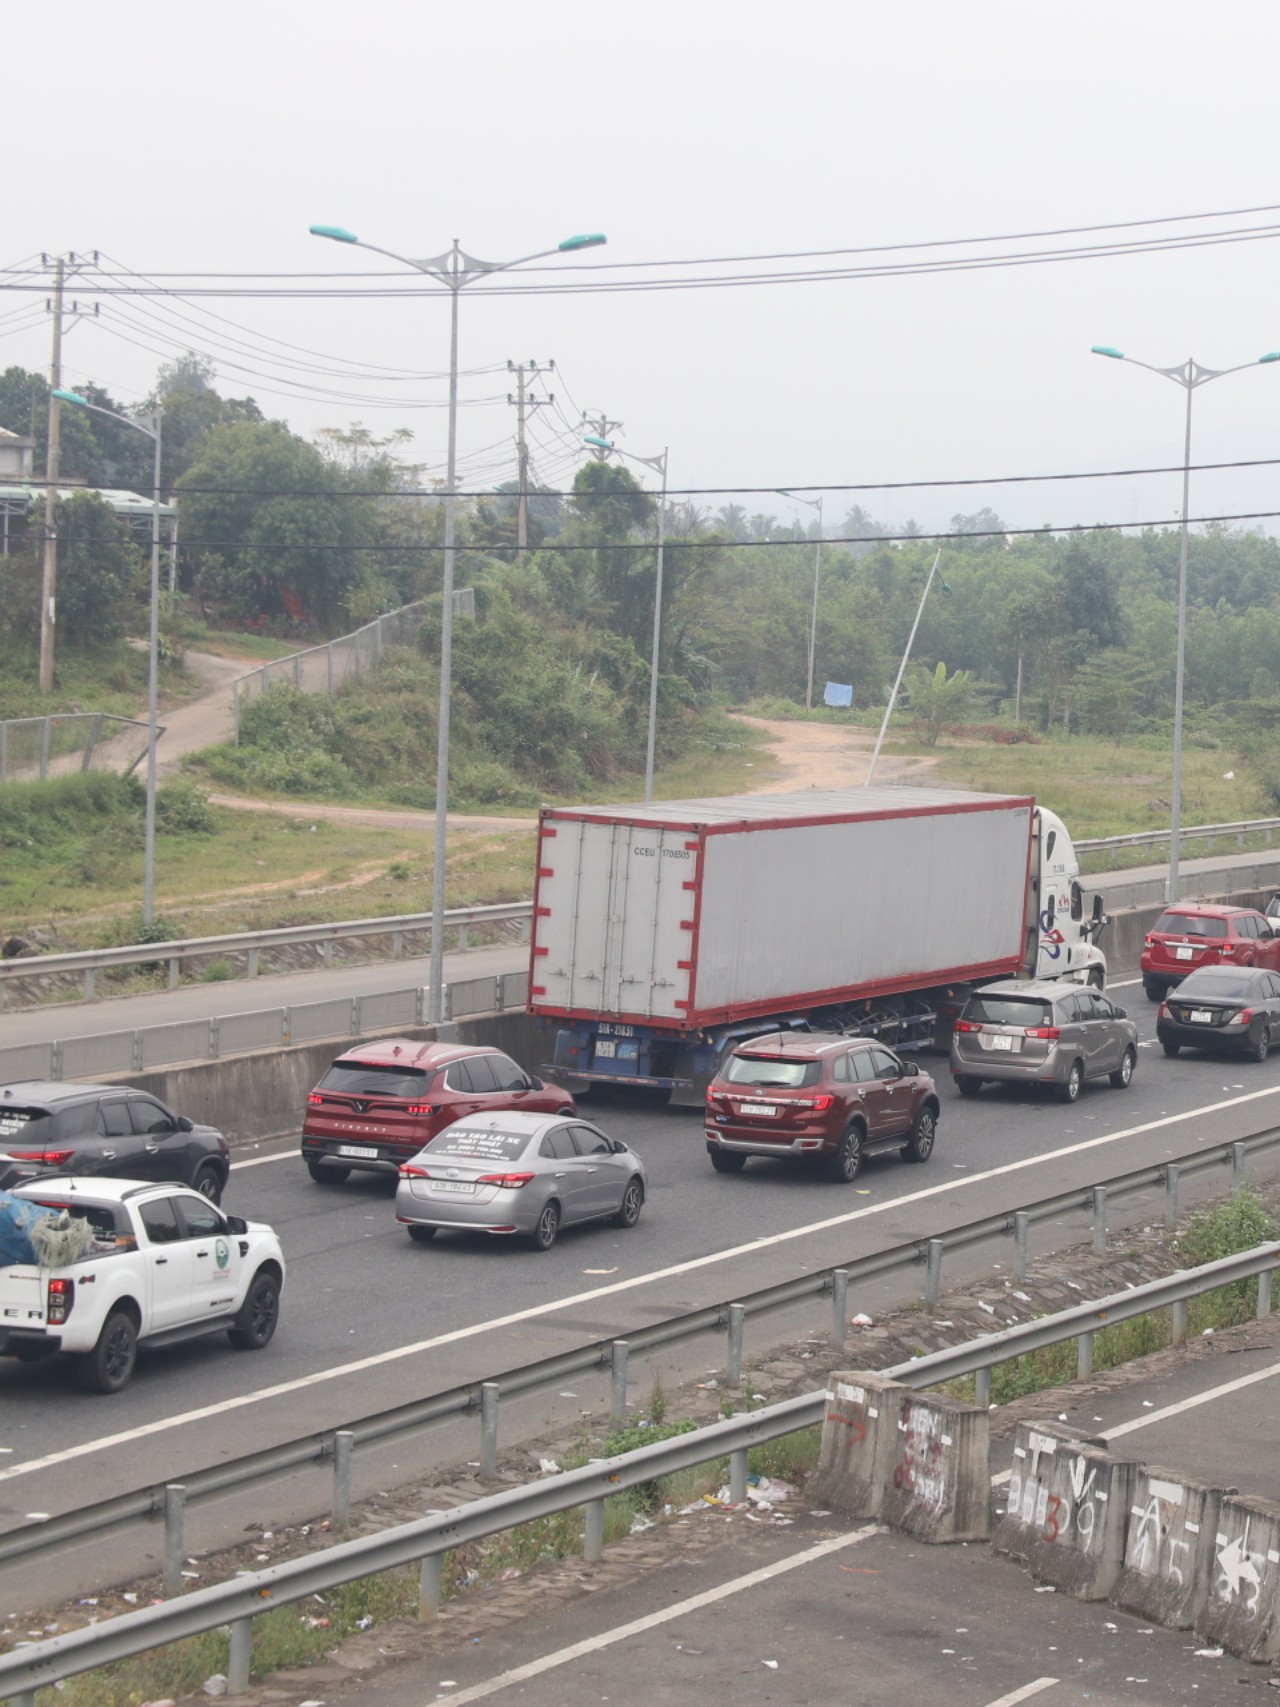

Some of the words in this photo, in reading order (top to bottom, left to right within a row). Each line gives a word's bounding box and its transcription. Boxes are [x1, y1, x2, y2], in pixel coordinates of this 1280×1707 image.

[634, 846, 656, 857] CCEU
[334, 1122, 387, 1133] VINFAST
[506, 1136, 521, 1144] XE
